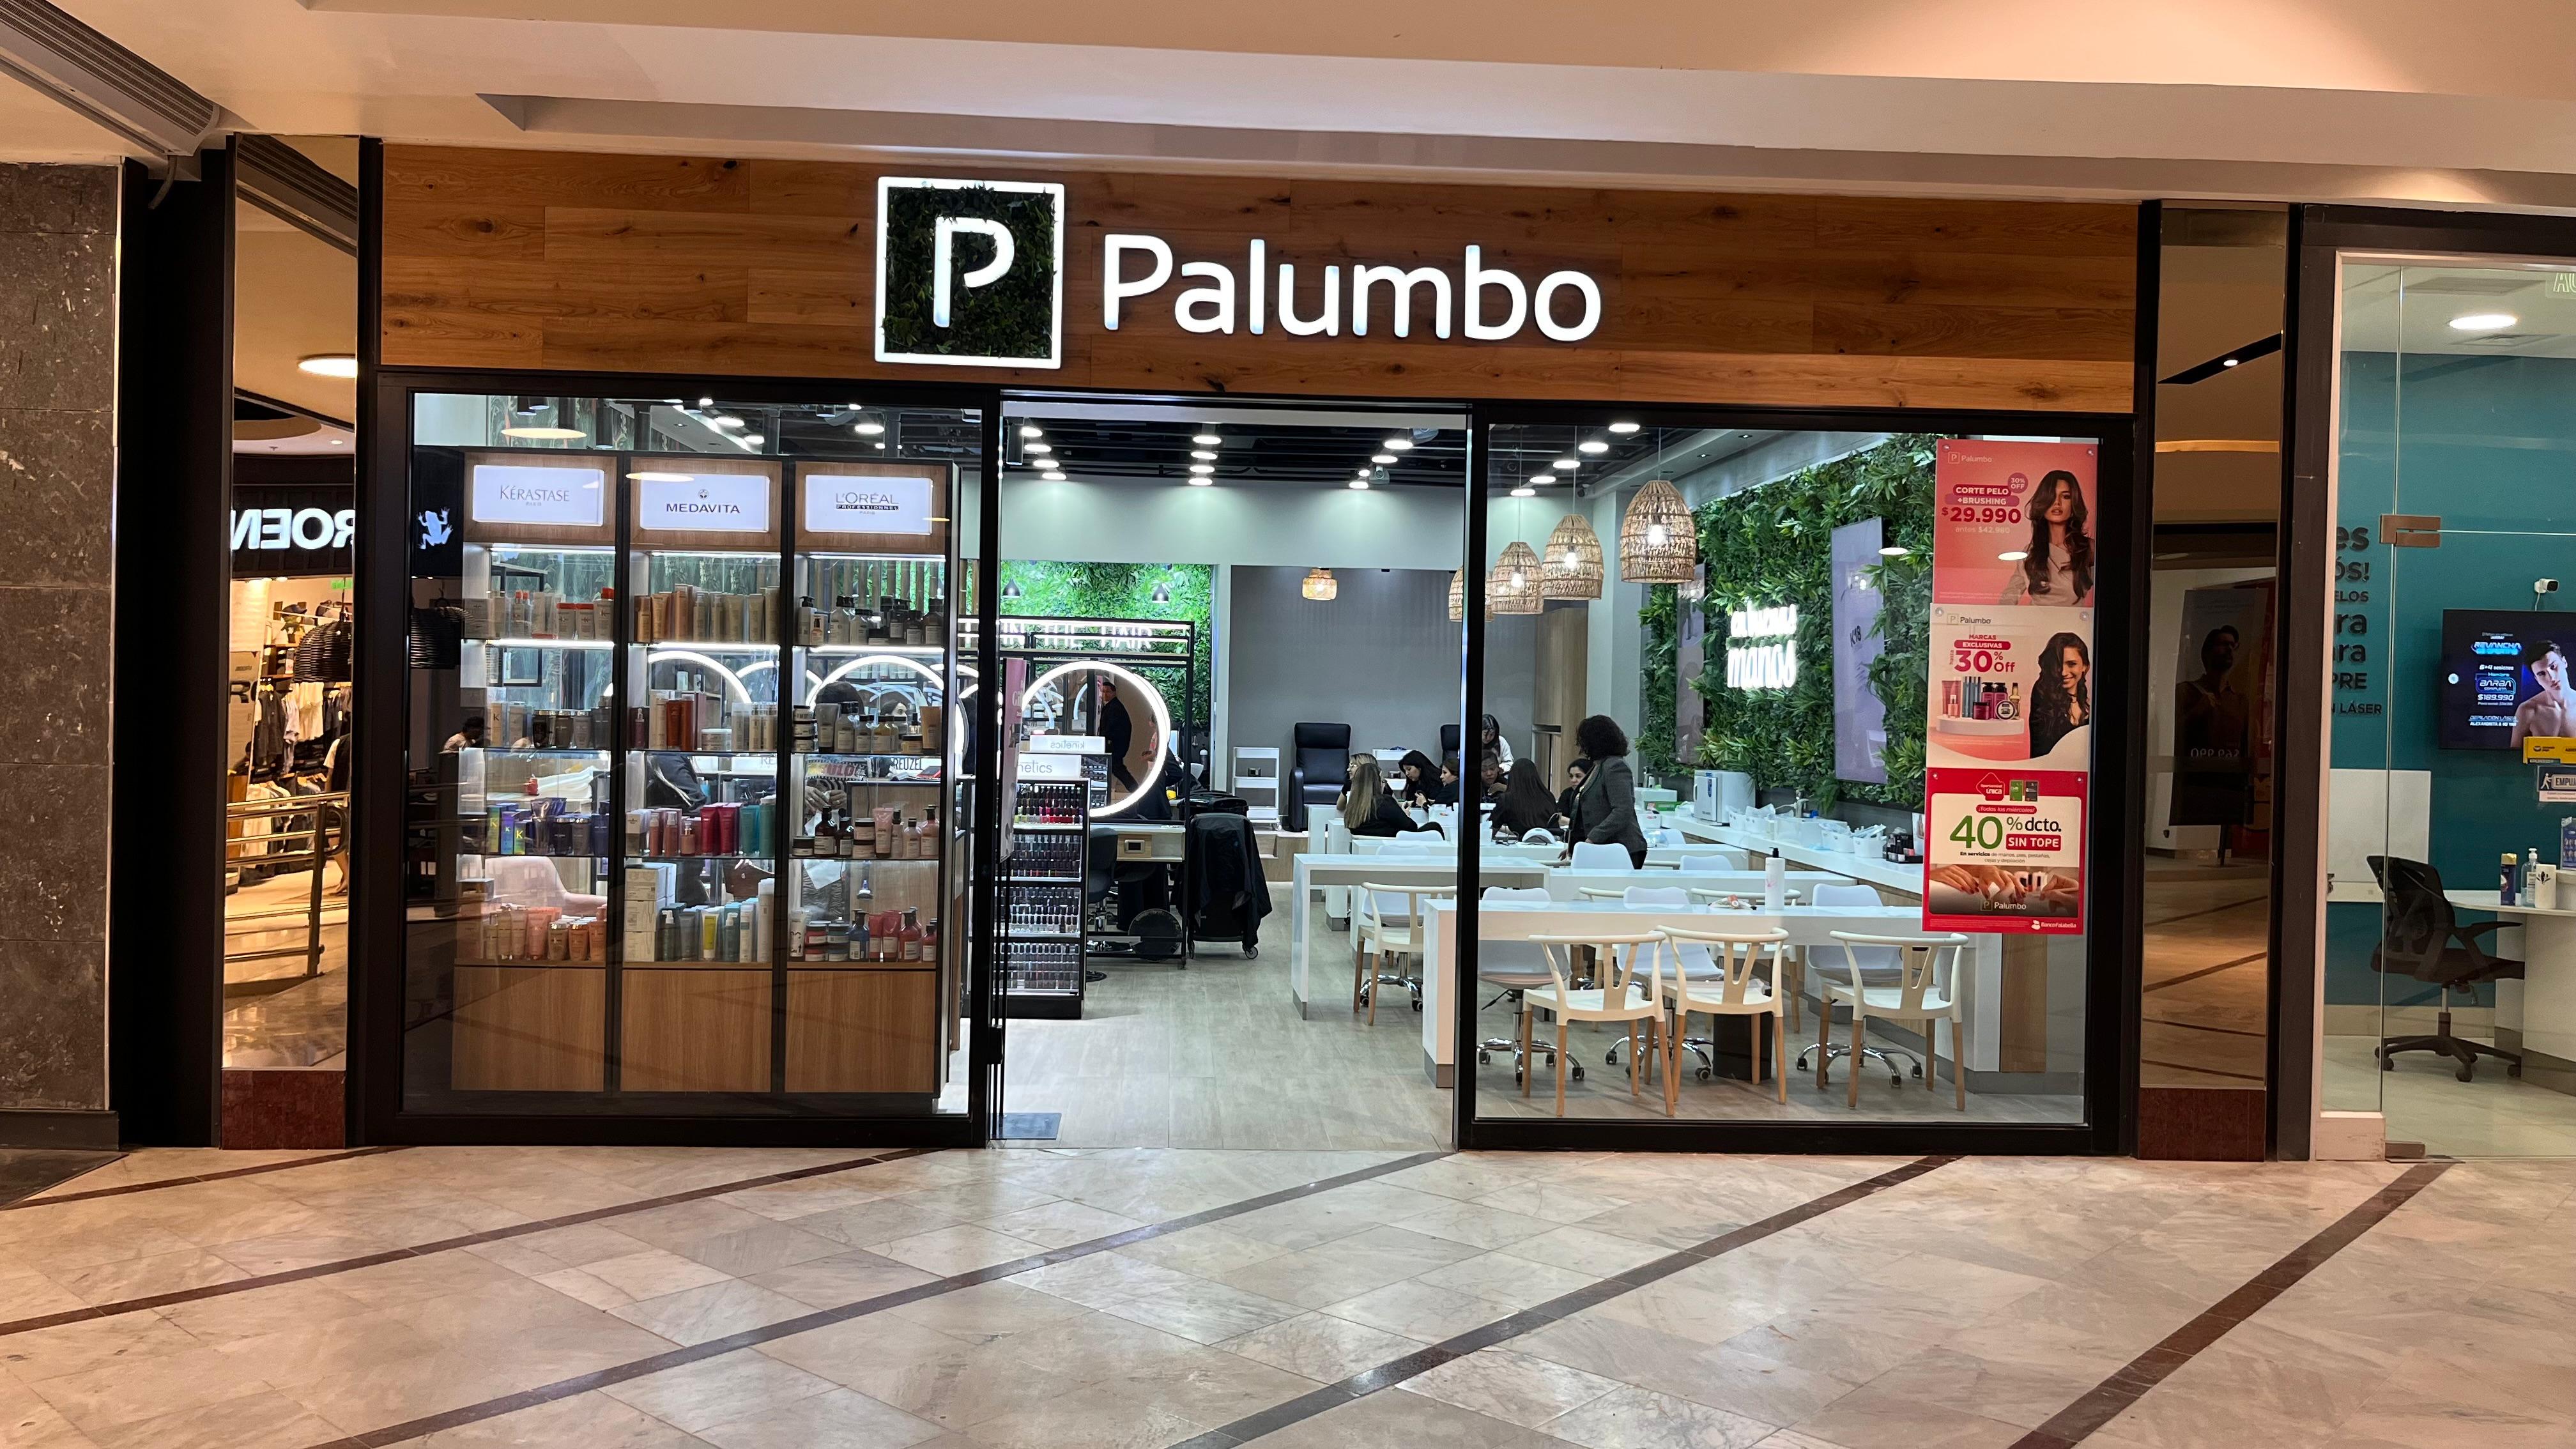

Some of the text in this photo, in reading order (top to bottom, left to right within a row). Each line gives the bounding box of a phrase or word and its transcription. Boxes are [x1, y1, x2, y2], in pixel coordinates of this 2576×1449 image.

[933, 216, 1602, 342] P Palumbo
[1961, 454, 1992, 463] Palumbo
[500, 485, 570, 502] KÉRASTASE
[1956, 486, 1984, 494] CORTE
[836, 492, 900, 504] L'ORÉAL
[666, 503, 740, 513] MEDAVITA
[1942, 507, 2021, 523] $29.990
[2340, 700, 2382, 714] LÁSER
[2025, 817, 2062, 832] dcto.
[2008, 837, 2059, 848] SIN TOPE
[1994, 901, 2026, 910] Palumbo
